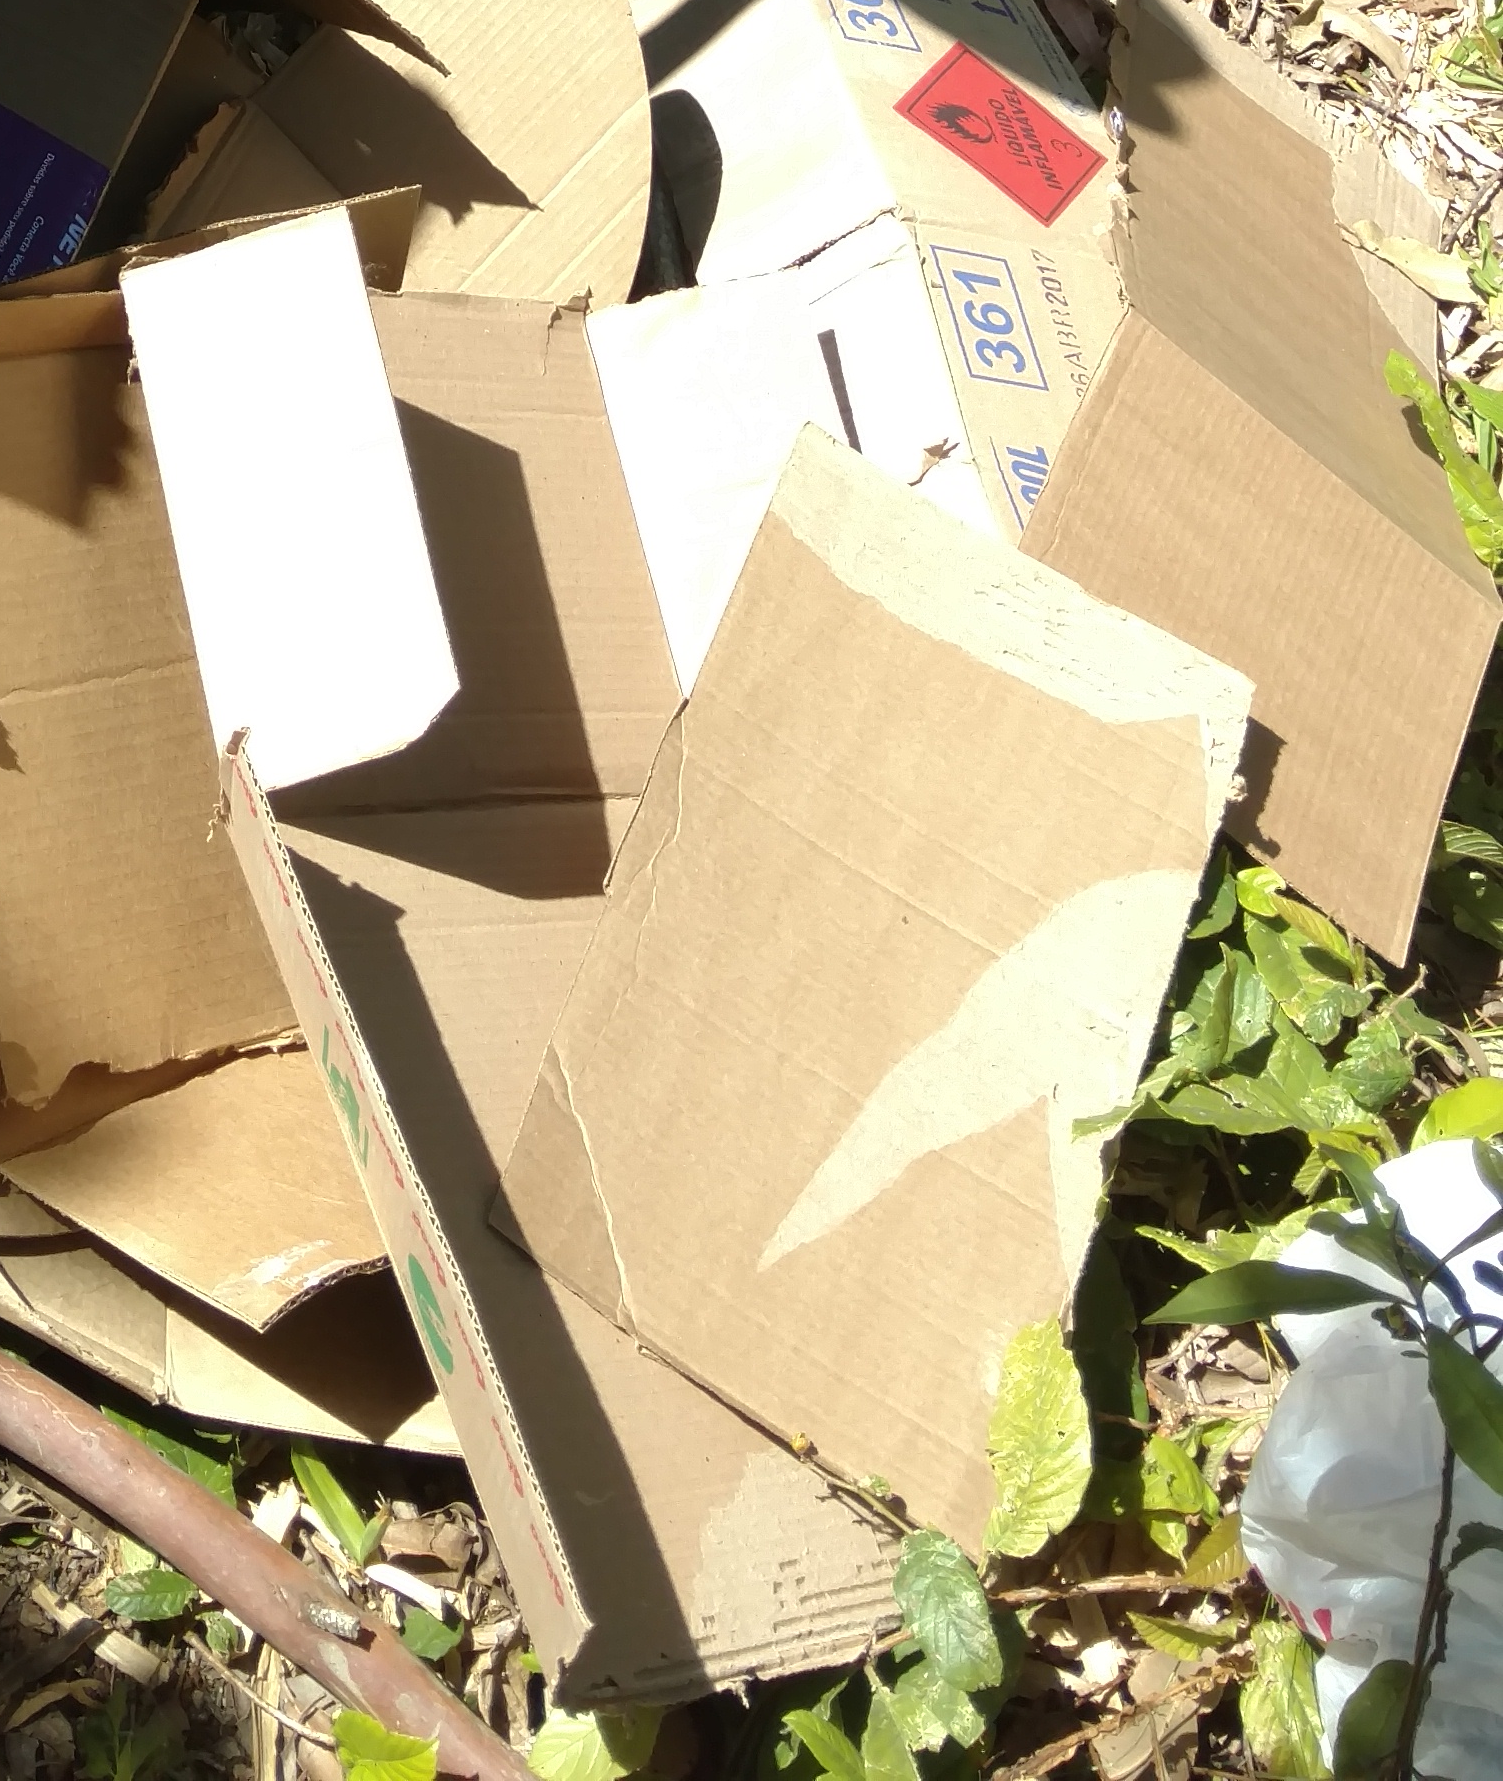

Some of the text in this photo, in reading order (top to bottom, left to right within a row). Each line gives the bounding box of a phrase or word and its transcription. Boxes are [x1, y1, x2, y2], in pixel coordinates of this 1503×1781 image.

[987, 98, 1033, 167] LÍQUIDO
[1002, 87, 1064, 191] INFLAMÁVEL
[32, 152, 55, 185] Dúvidas
[21, 182, 37, 207] sobre
[19, 215, 45, 253] Conecta
[6, 251, 26, 277] Você
[951, 269, 1027, 374] 361
